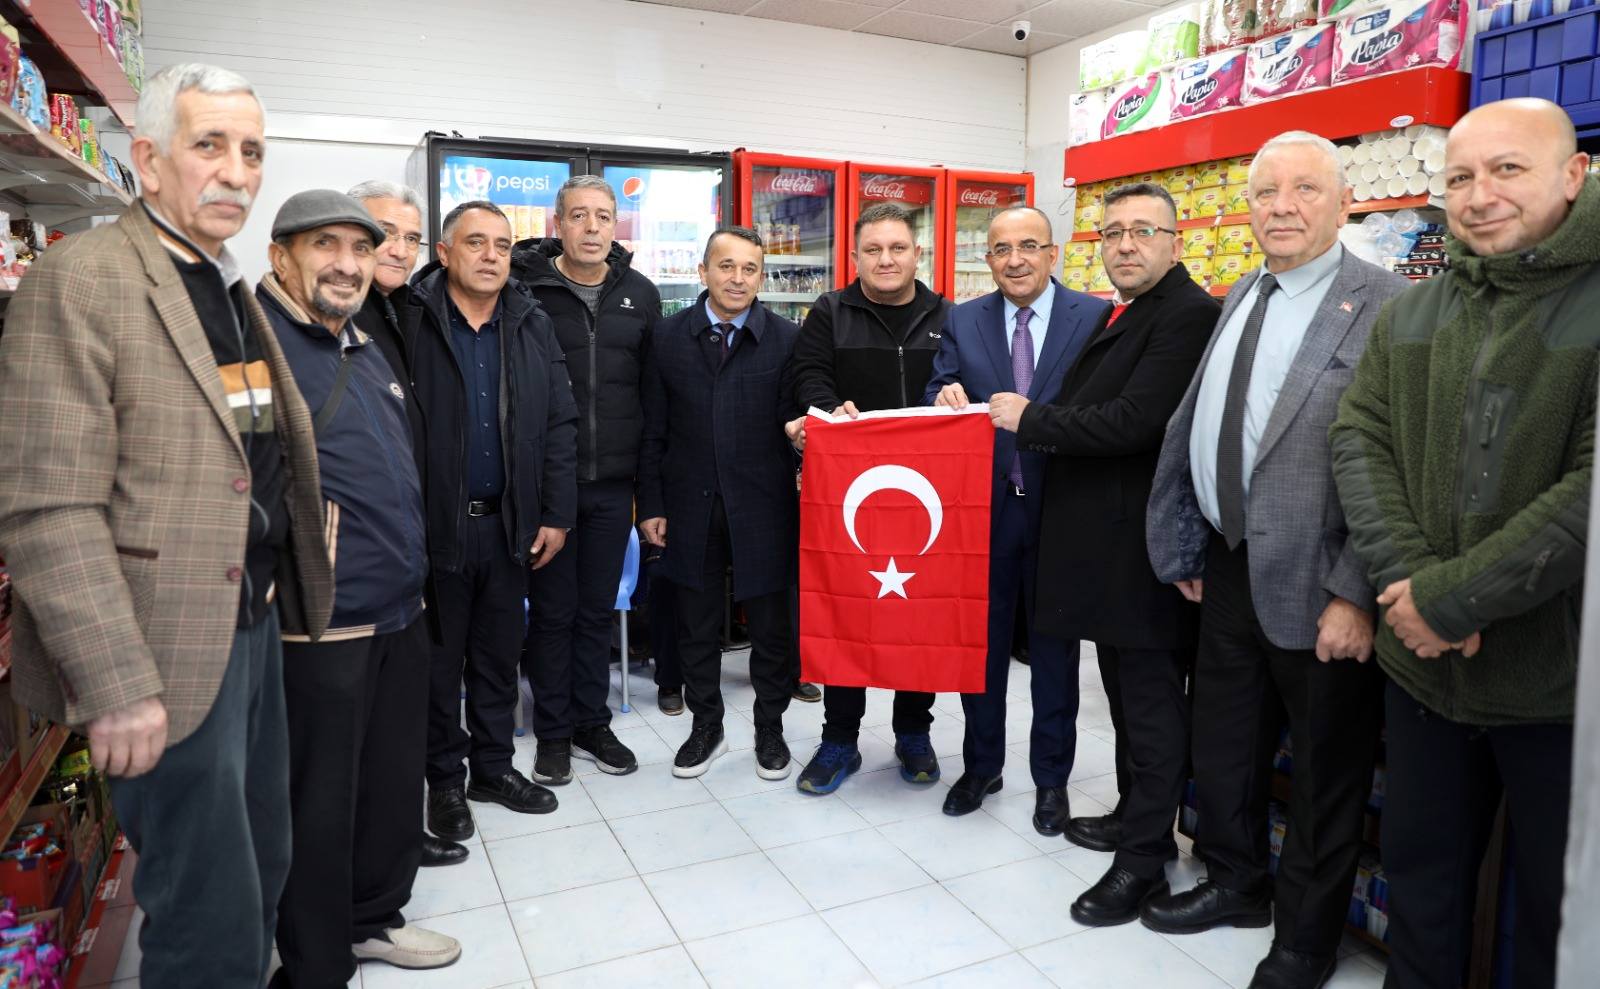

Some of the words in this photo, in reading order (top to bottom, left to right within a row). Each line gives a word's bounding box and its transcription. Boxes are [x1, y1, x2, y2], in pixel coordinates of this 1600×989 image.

[1353, 31, 1401, 62] Papia
[1183, 77, 1217, 104] Papia
[1114, 94, 1145, 118] Papia
[496, 175, 549, 192] pepsi
